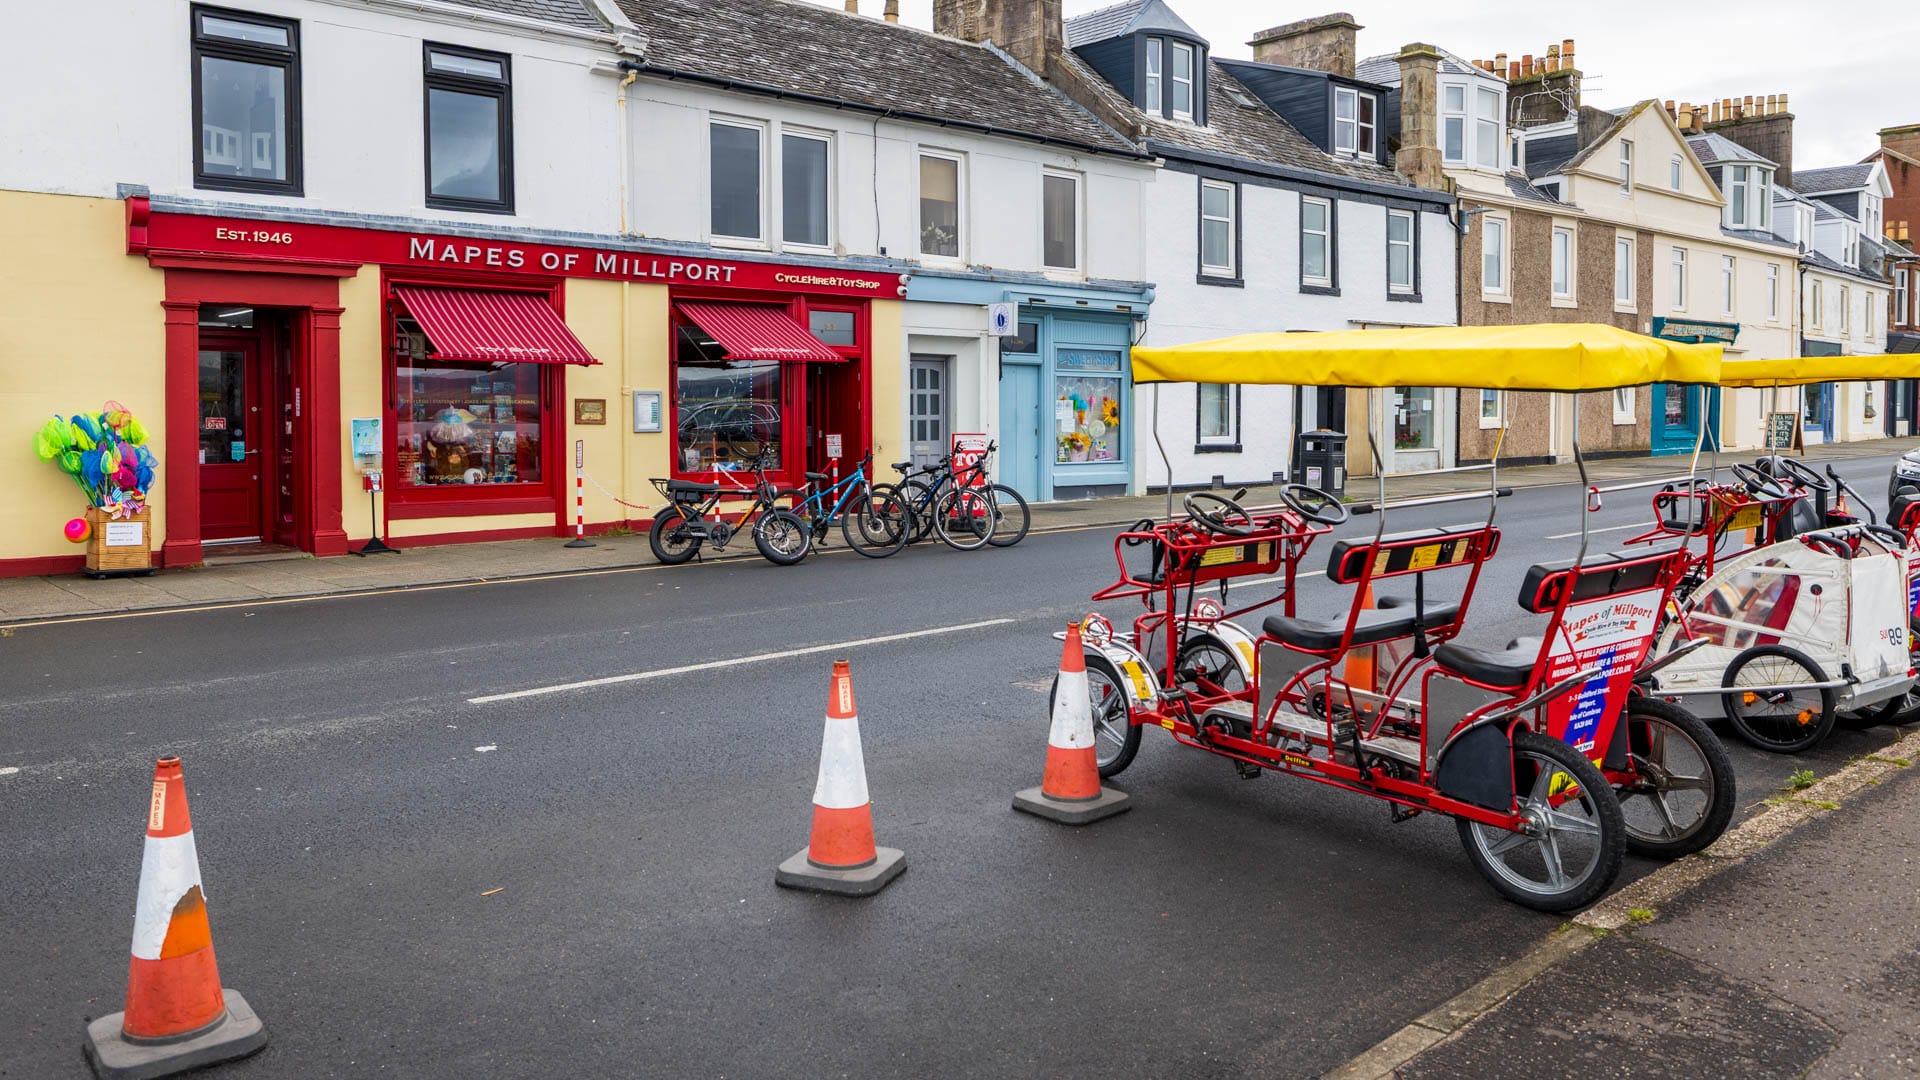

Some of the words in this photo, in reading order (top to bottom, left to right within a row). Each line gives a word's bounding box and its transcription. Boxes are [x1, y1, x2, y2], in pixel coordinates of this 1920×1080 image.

[216, 227, 293, 244] EST.1946
[408, 237, 525, 268] MAPES
[541, 252, 580, 271] OF
[595, 253, 738, 282] MILLPORT
[955, 452, 986, 467] TO
[1601, 605, 1614, 621] of
[1613, 603, 1653, 619] Millport
[1888, 627, 1903, 646] 89
[1555, 654, 1574, 665] MAPES
[1576, 651, 1584, 660] OF
[1583, 647, 1609, 659] MILLPORT
[1609, 645, 1616, 653] IS
[1616, 638, 1643, 651] CUMBRAES
[1552, 665, 1577, 678] NUMBER
[1605, 657, 1611, 667] &
[1612, 654, 1625, 664] TOYS
[1624, 650, 1640, 662] SHOP
[153, 792, 162, 826] MAPES
